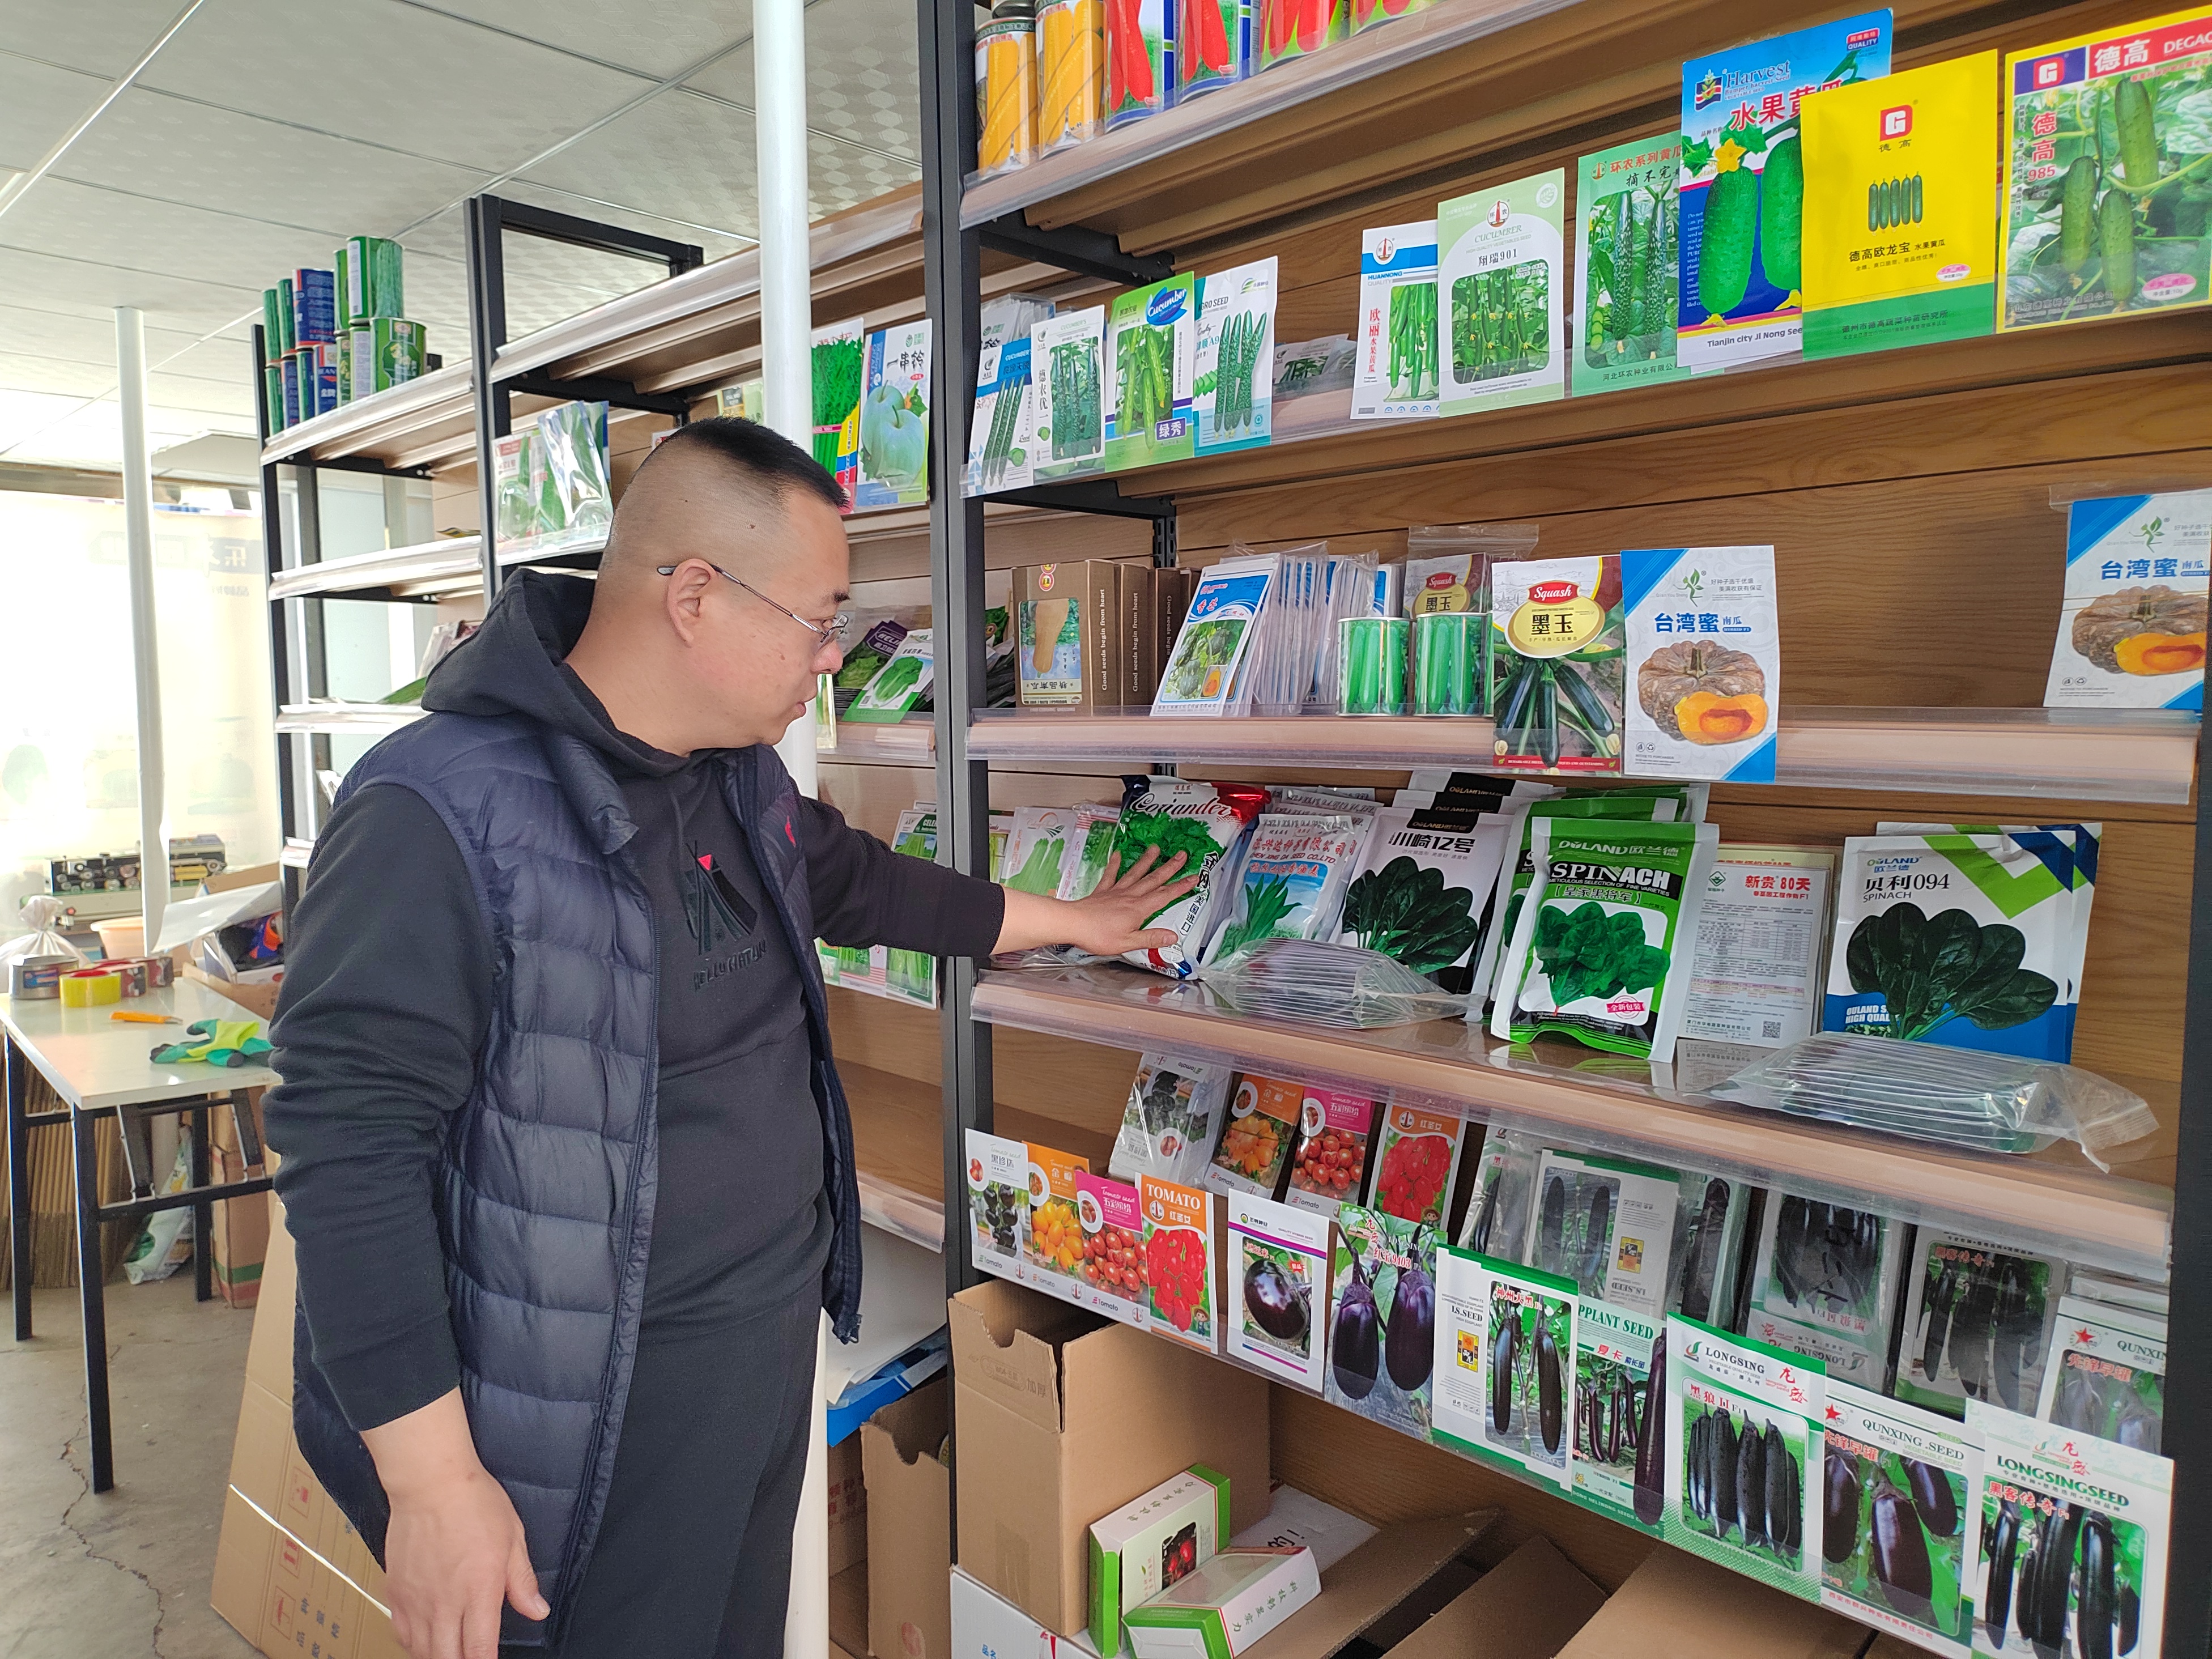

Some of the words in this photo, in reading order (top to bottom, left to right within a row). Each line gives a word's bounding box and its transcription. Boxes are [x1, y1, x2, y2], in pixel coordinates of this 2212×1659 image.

[1848, 37, 1878, 50] QUALITY
[2094, 39, 2151, 73] 德高
[1726, 59, 1790, 88] Harvest
[1725, 85, 1750, 95] Bumper
[1750, 78, 1773, 88] harvest
[1725, 90, 1752, 100] VEGETABLE
[1878, 138, 1913, 152] 德高
[2031, 112, 2057, 163] 德高
[2027, 165, 2056, 182] 985
[1474, 224, 1522, 243] CUCUMBER
[1477, 243, 1492, 252] QUALITY
[1494, 237, 1520, 248] VEGETABLES
[1849, 242, 1911, 262] 德高欧龙宝
[1914, 239, 1946, 251] 水果黄瓜
[1367, 271, 1403, 280] HUANNONG
[1147, 288, 1188, 317] Cucumber
[1213, 296, 1229, 306] SEED
[1707, 335, 1735, 348] Tianjin
[1737, 333, 1753, 345] city
[1763, 329, 1786, 341] Nong
[886, 350, 924, 373] 一串铃
[1159, 420, 1182, 439] 绿秀
[2100, 558, 2178, 580] 台湾蜜
[2181, 560, 2204, 570] 南瓜
[1428, 575, 1453, 588] Squash
[1534, 584, 1572, 601] Squash
[1425, 594, 1452, 612] 墨玉
[1531, 613, 1573, 635] 墨玉
[1654, 612, 1720, 634] 台湾蜜
[1722, 616, 1742, 626] 南瓜
[1134, 793, 1231, 815] Coriander
[1393, 832, 1476, 853] 川崎12号
[1628, 845, 1679, 857] 欧兰德
[1551, 863, 1671, 890] SPINACH
[1874, 865, 1909, 873] 欧兰德
[1640, 886, 1670, 896] VARIETIES
[1745, 875, 1775, 888] 新贵
[1780, 877, 1811, 891] 80天
[1863, 873, 1950, 895] 贝利094
[1863, 891, 1912, 903] SPINACH
[1845, 1014, 1866, 1024] HIGH
[1846, 1005, 1879, 1015] OULAND
[1330, 1102, 1359, 1117] 五彩缤纷
[1419, 1120, 1443, 1132] 红圣女
[991, 1154, 1014, 1168] 黑珍珠
[1146, 1184, 1201, 1210] TOMATO
[1388, 1236, 1422, 1252] LONGSING
[1622, 1320, 1654, 1340] SEED
[1705, 1346, 1765, 1374] LONGSING
[1709, 1359, 1732, 1370] VEGETABLE
[1732, 1366, 1750, 1375] QUALITY
[1027, 1377, 1047, 1398] 加厚
[1779, 1366, 1809, 1404] 龙盛
[1732, 1403, 1742, 1414] F1
[1862, 1419, 1922, 1447] QUNXING
[1939, 1432, 1961, 1443] SEED
[1904, 1443, 1943, 1461] VEGETABLE
[1944, 1457, 1963, 1467] SEED
[2062, 1441, 2091, 1476] 龙盛
[1997, 1454, 2130, 1507] LONGSINGSEED
[1988, 1481, 2056, 1516] 黑客传奇
[2058, 1507, 2070, 1520] F1
[1618, 1509, 1634, 1520] SEEDS
